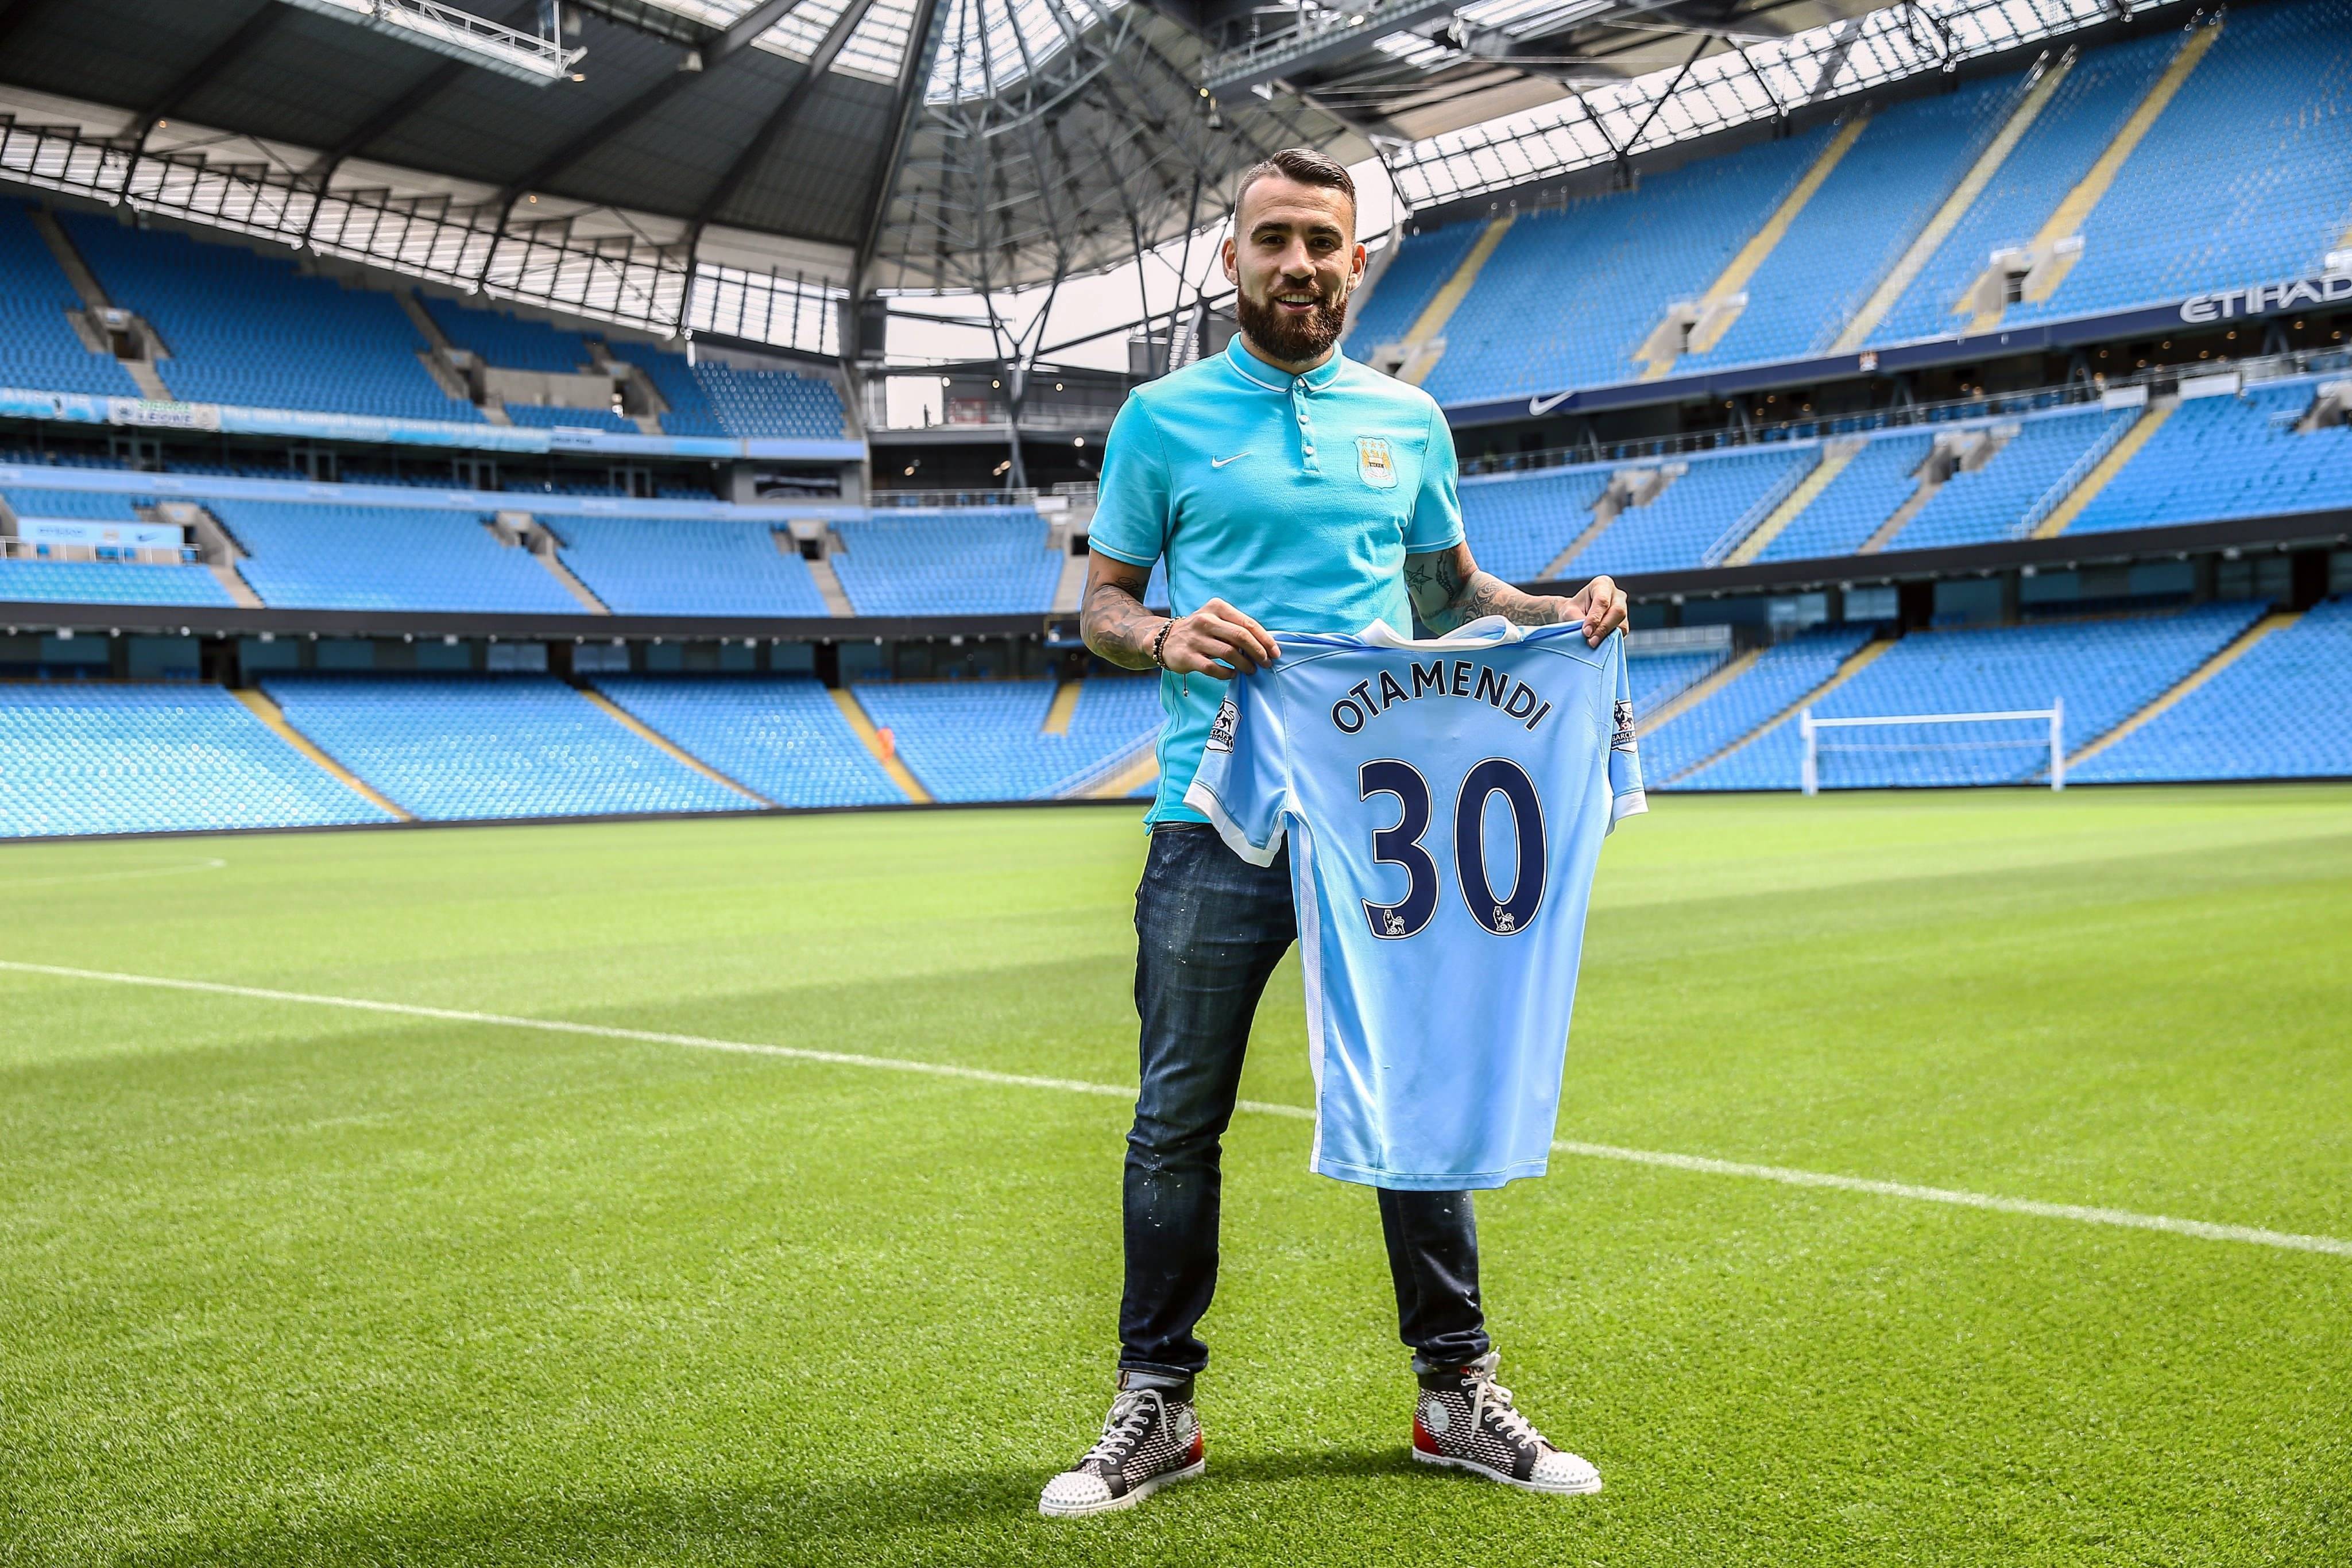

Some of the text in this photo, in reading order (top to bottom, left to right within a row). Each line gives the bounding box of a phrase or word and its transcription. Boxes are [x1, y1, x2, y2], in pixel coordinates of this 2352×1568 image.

[2180, 272, 2352, 323] ETIHAD
[1331, 659, 1553, 735] OTAMENDI
[1210, 729, 1229, 741] CLAYS
[1358, 757, 1548, 940] 30
